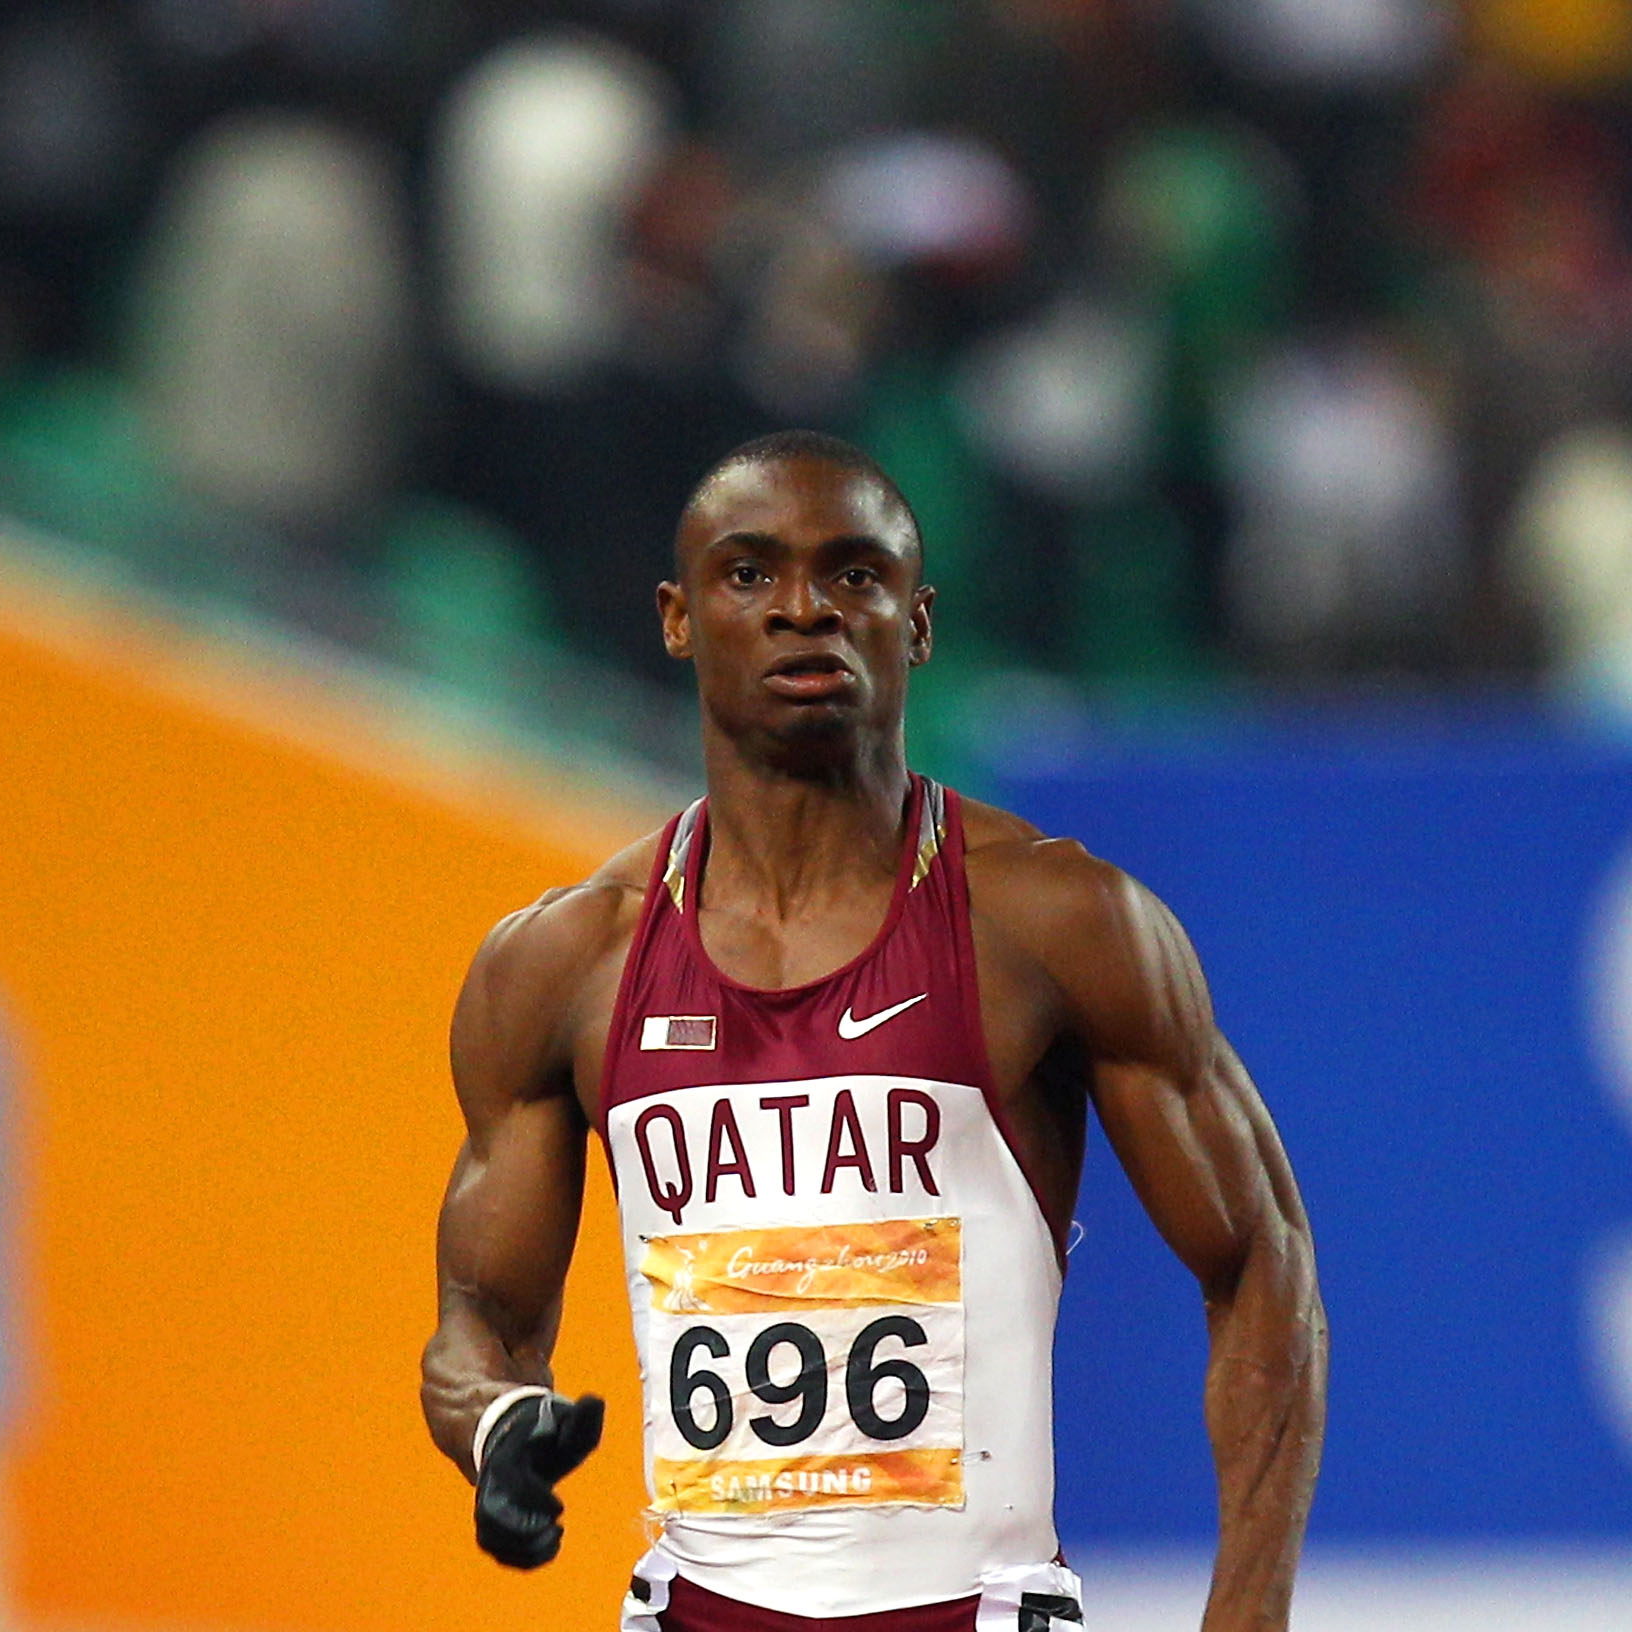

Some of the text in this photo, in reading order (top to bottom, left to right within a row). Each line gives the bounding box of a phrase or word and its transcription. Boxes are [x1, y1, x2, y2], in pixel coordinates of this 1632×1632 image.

[634, 1087, 942, 1226] QATAR
[670, 1315, 931, 1450] 696
[709, 1466, 872, 1502] SAMSUNG
